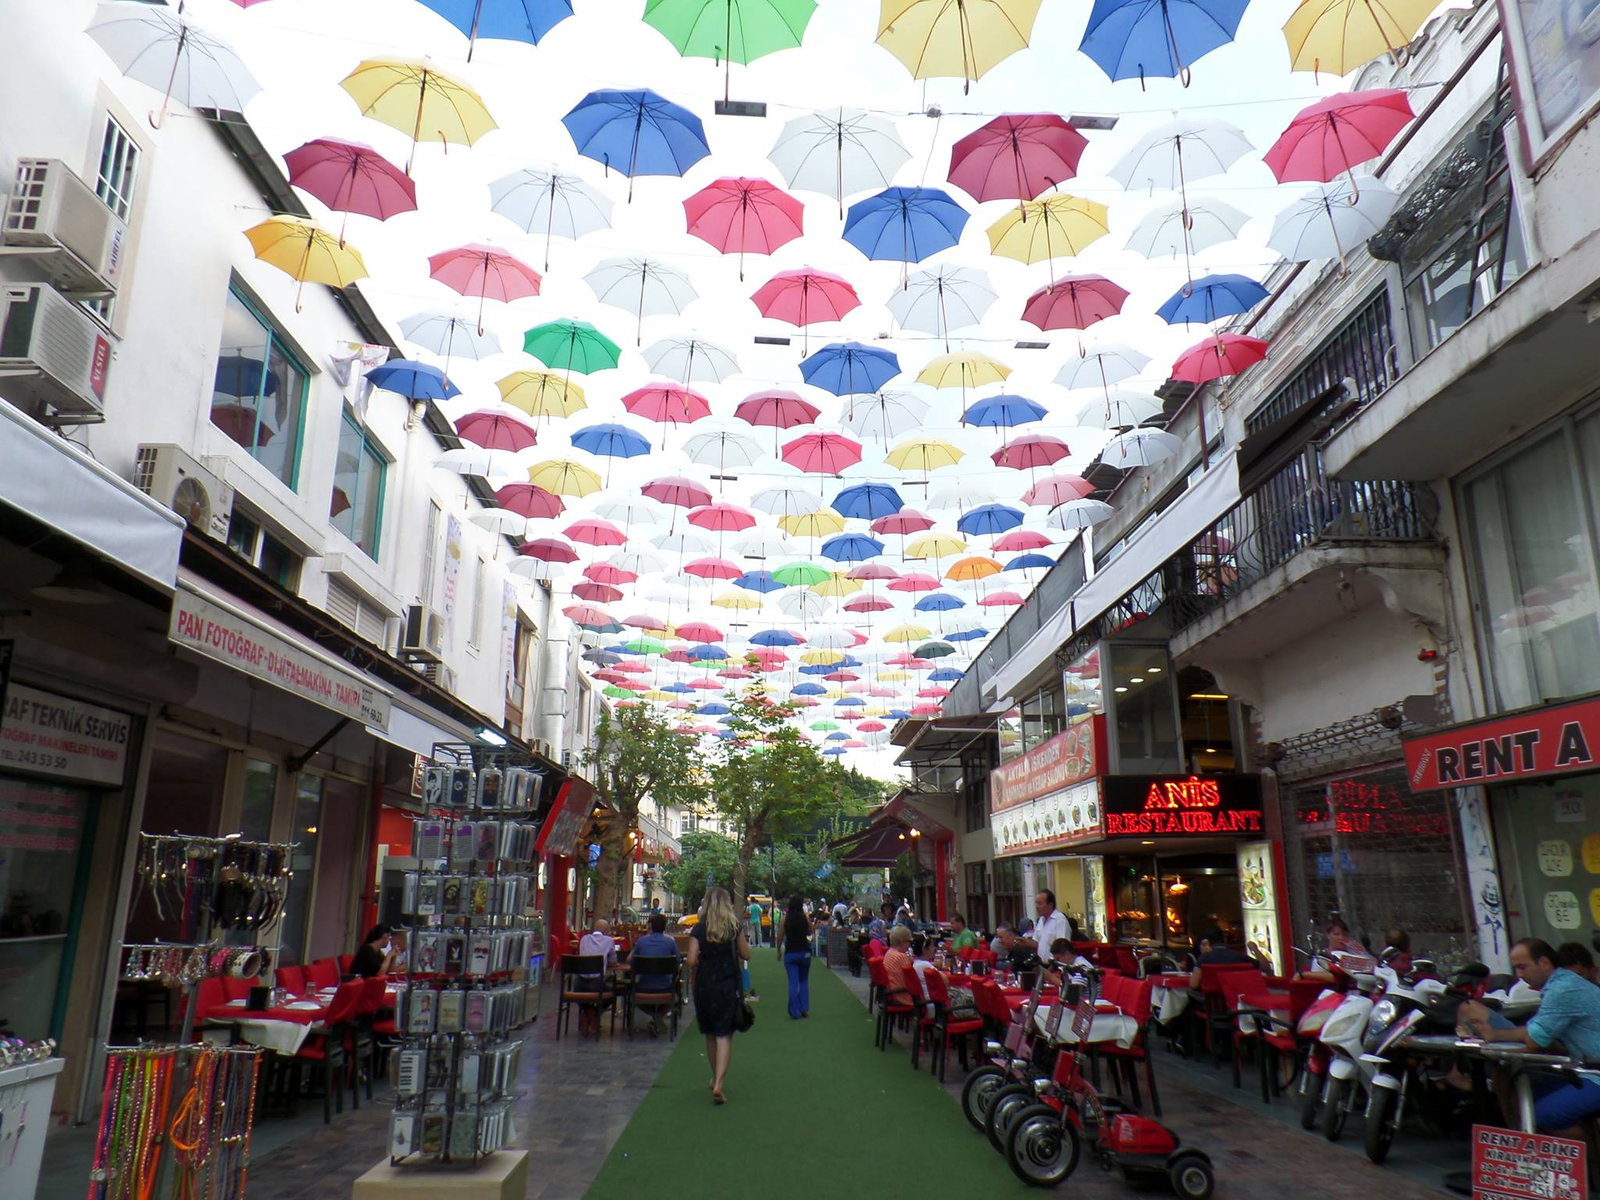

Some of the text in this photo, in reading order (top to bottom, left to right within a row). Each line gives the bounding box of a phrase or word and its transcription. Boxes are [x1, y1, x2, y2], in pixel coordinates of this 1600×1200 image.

[111, 229, 122, 267] AIRFEL
[177, 609, 204, 641] PAN
[31, 701, 85, 735] TEKNİK
[85, 715, 128, 744] SERVİS
[18, 750, 37, 763] 243
[39, 752, 53, 767] 53
[1435, 729, 1541, 785] RENT
[1555, 721, 1593, 767] A
[1144, 775, 1220, 810] ANİS
[1106, 810, 1262, 834] RESTAURANT
[1479, 1131, 1580, 1159] RENT A BİKE
